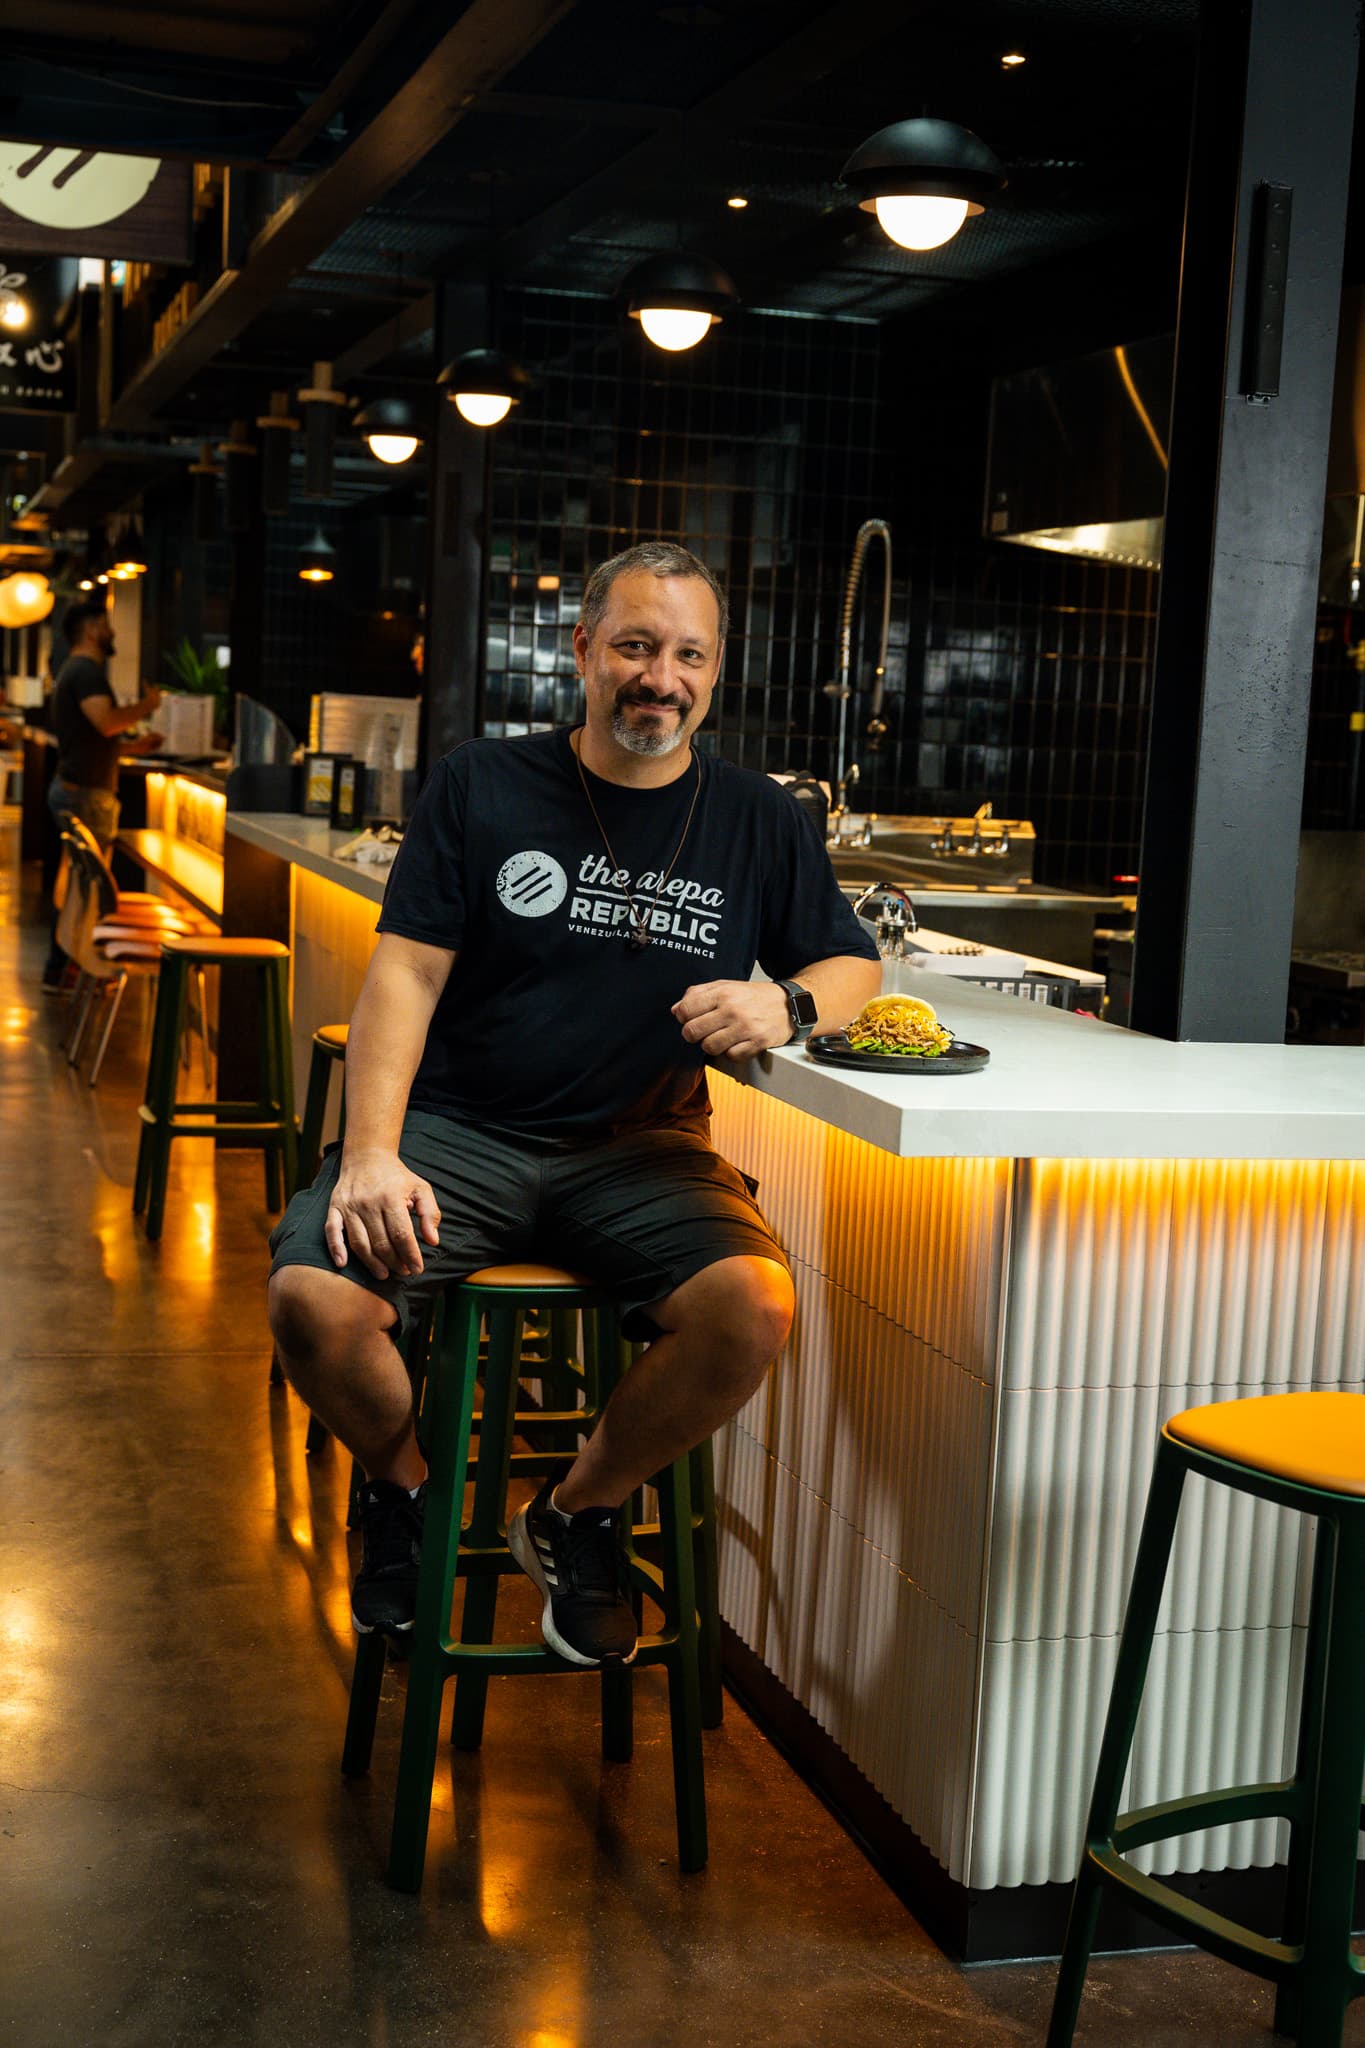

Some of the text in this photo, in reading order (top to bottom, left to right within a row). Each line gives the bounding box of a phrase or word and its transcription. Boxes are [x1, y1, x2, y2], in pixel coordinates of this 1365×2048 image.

[578, 854, 725, 909] the arepa
[568, 923, 715, 959] VENEZULA XPERIENCE
[570, 897, 719, 945] REPUBLIC
